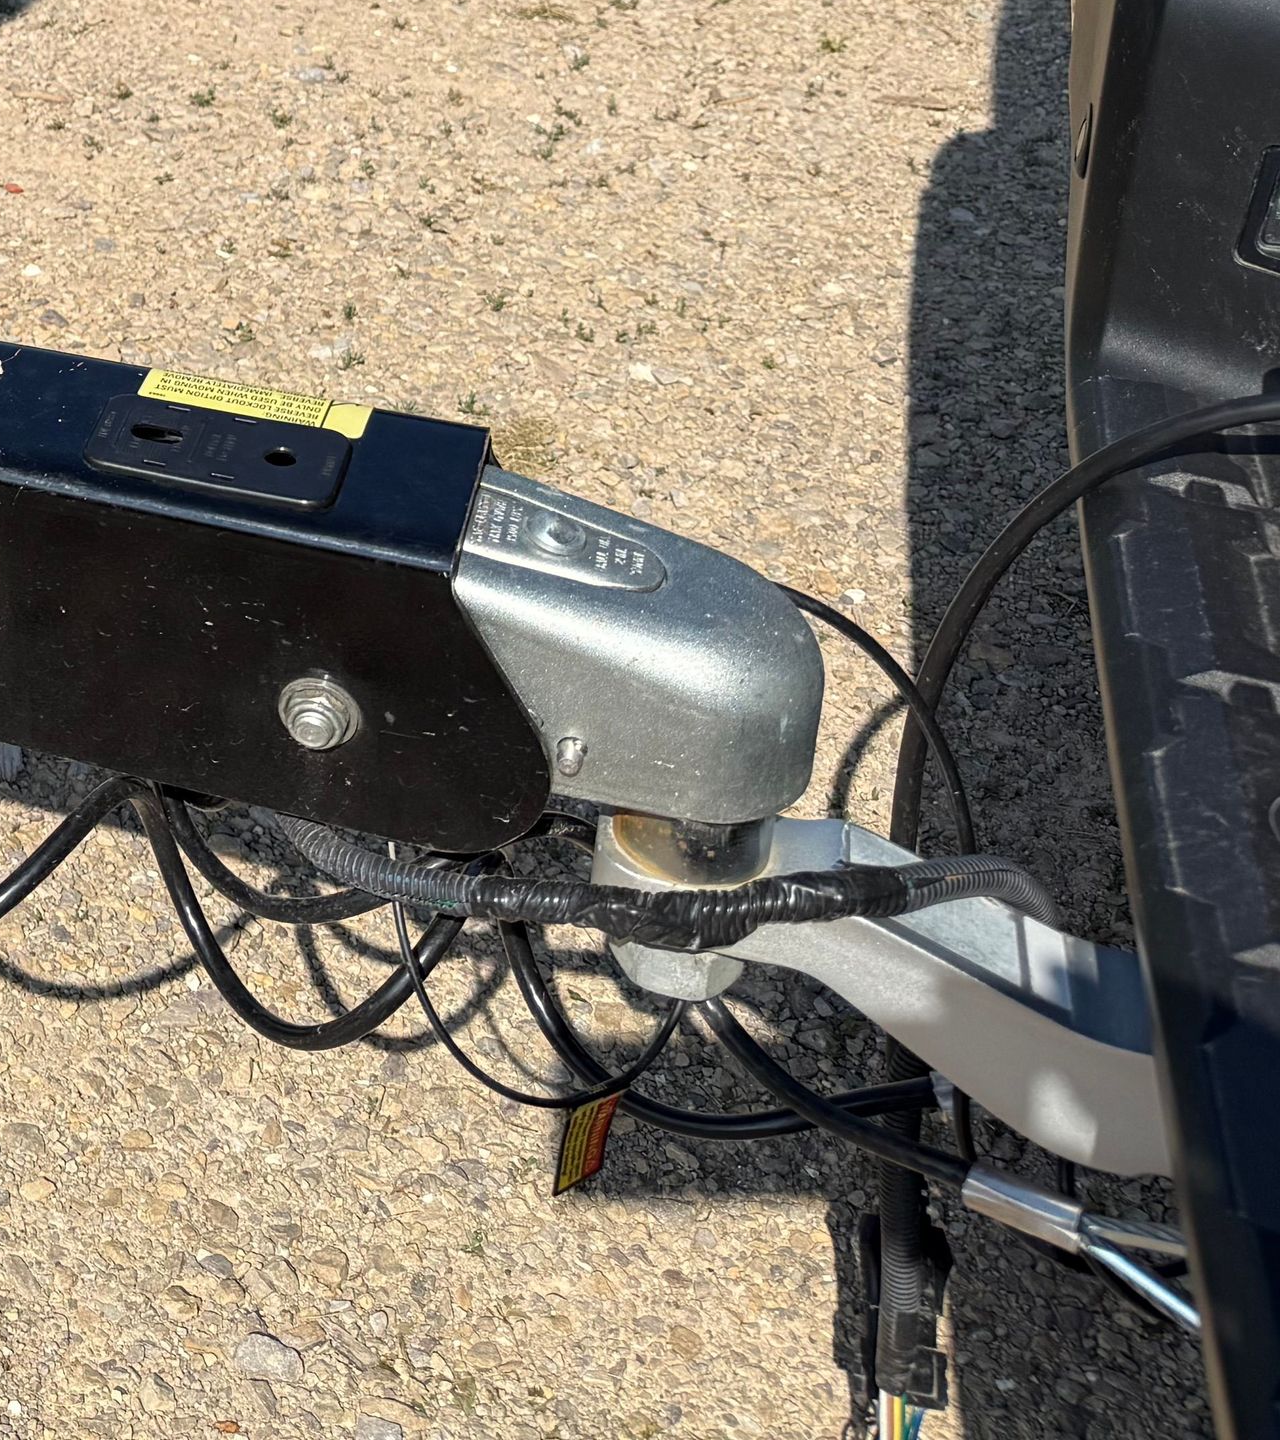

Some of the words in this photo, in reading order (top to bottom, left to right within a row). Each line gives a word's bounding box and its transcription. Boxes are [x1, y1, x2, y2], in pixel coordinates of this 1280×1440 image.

[164, 372, 204, 384] REMOVE
[155, 383, 184, 394] MUST
[173, 380, 215, 393] MOVING
[205, 380, 273, 397] IMMEDIATELY
[185, 389, 224, 402] OPTION
[216, 388, 248, 399] WHEN
[225, 397, 272, 411] LOCKOUT
[250, 395, 278, 405] USED
[275, 406, 319, 420] REVERSE
[295, 404, 322, 413] ONLY
